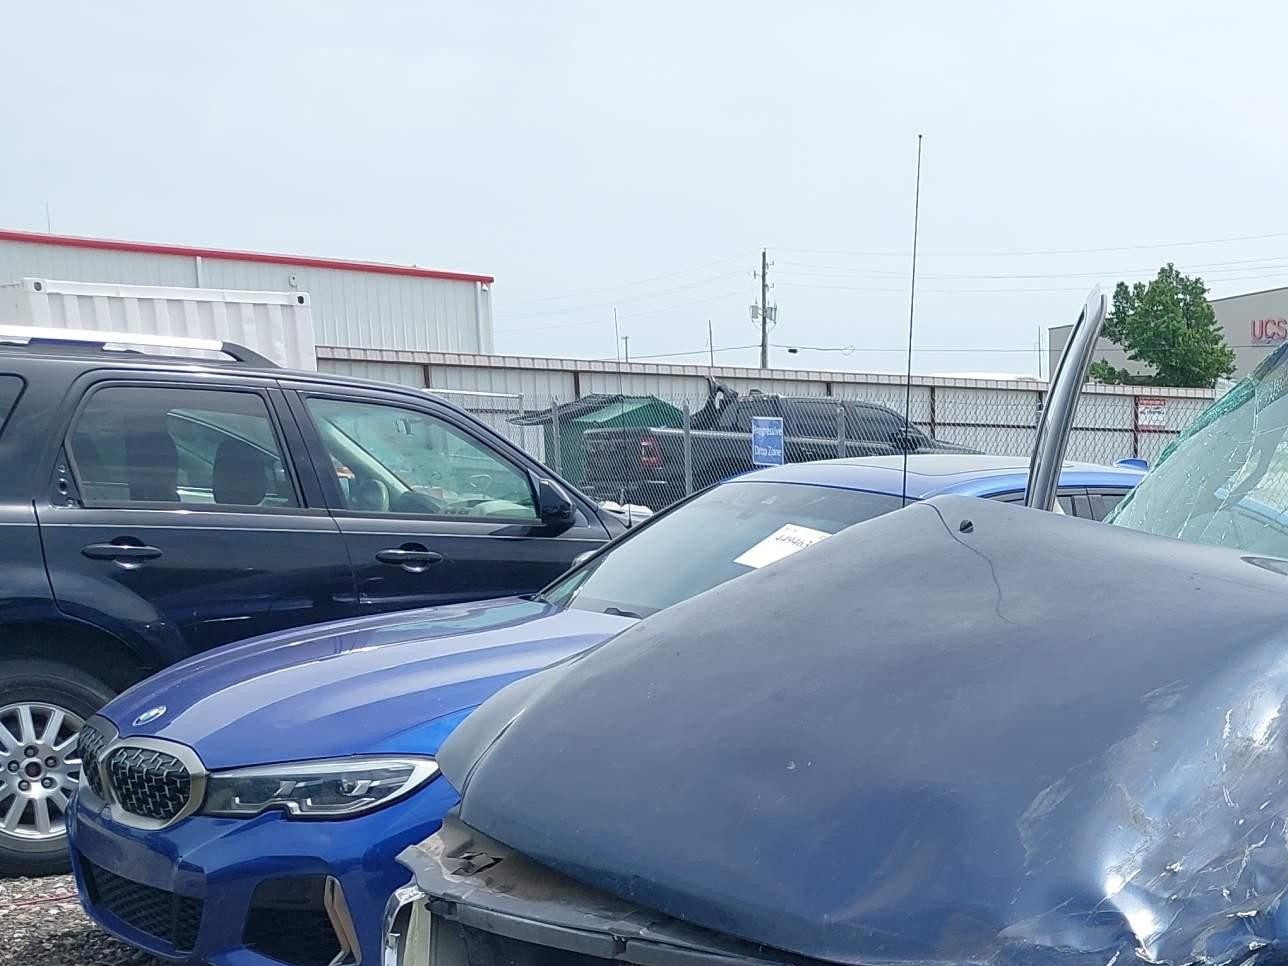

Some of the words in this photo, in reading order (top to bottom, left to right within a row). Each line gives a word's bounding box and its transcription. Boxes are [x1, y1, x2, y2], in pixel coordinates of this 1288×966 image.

[1251, 319, 1288, 339] UCS
[755, 445, 767, 456] Drop
[768, 446, 782, 456] Zone
